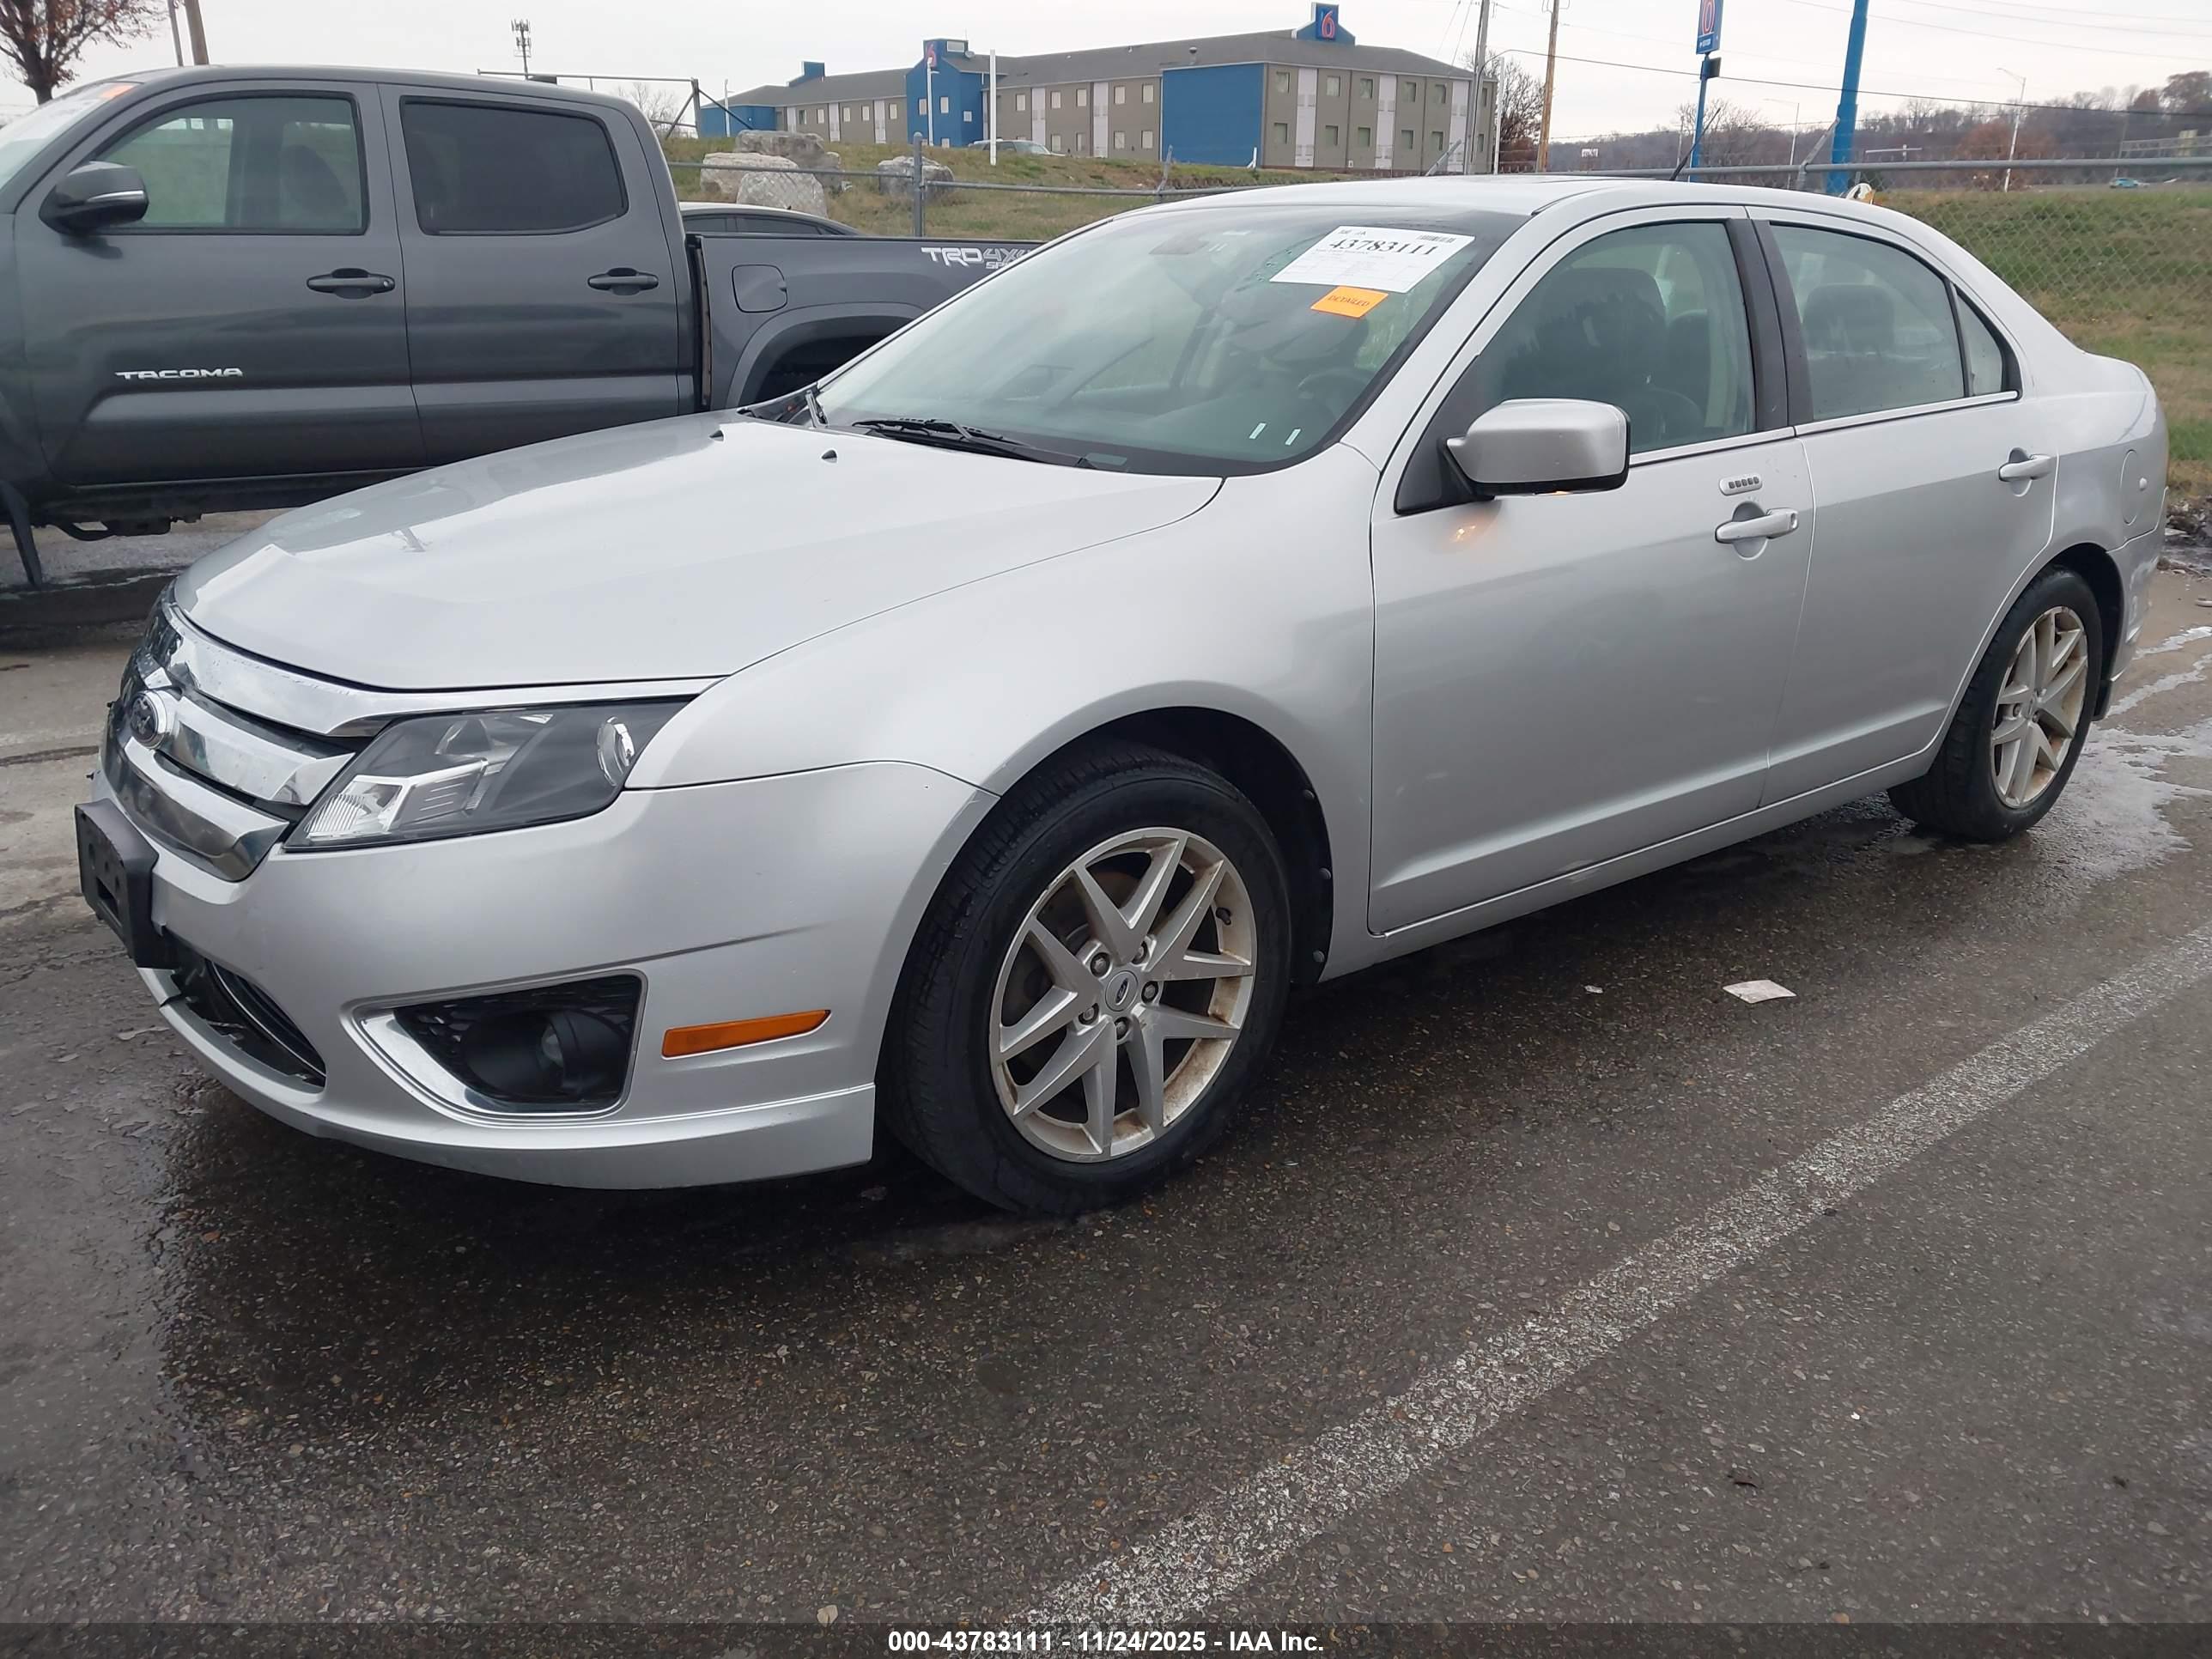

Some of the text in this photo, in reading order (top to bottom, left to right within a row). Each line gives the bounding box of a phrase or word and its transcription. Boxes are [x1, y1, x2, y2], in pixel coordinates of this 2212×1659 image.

[1322, 10, 1335, 39] 6
[1329, 238, 1438, 255] 43783111
[921, 246, 983, 268] TRD
[114, 368, 243, 380] TACOMA
